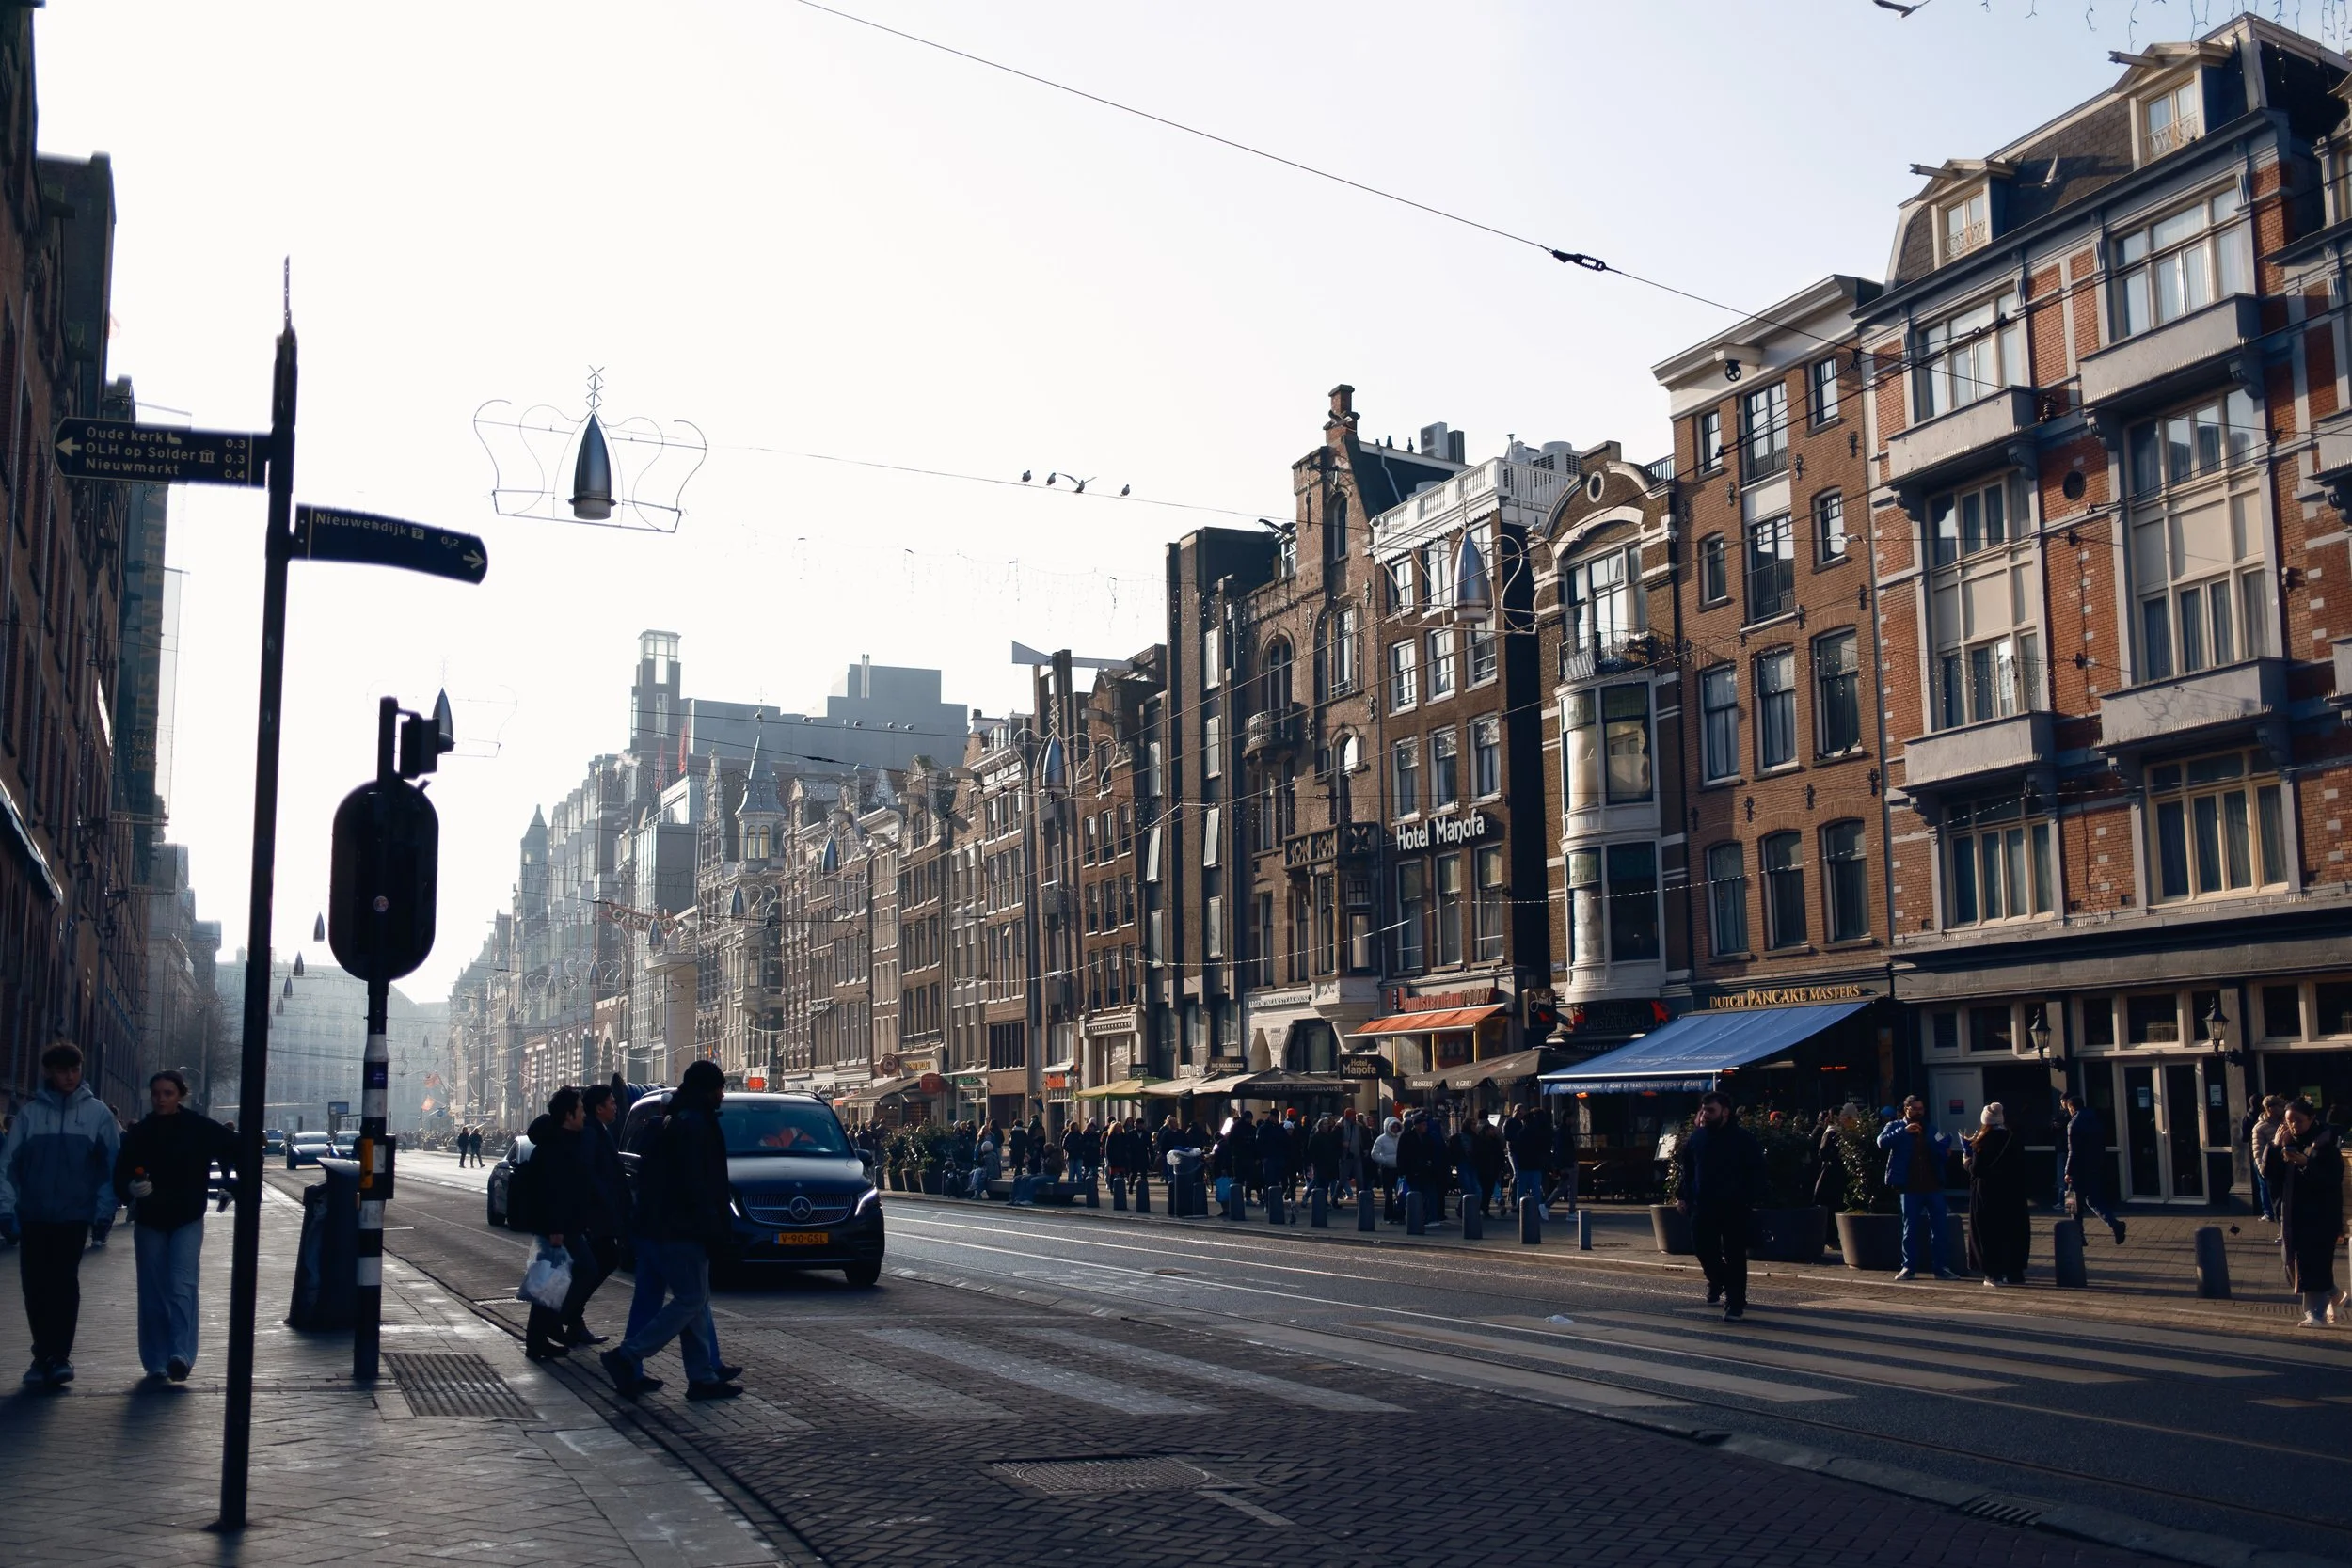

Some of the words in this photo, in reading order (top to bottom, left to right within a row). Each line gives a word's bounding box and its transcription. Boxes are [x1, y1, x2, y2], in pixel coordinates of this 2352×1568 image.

[87, 426, 125, 440] Oude
[131, 430, 164, 444] kerk
[225, 438, 246, 449] 0.3
[86, 442, 119, 455] OLH
[124, 448, 142, 458] op
[148, 447, 196, 461] Solder
[225, 453, 246, 464] 0.3
[86, 458, 179, 475] Nieuwmarkt
[224, 469, 245, 479] 0.4
[315, 512, 407, 536] Nieuwendijk
[1396, 819, 1429, 851] Hotel
[1434, 808, 1485, 845] Manofa
[1709, 994, 1744, 1009] DUTCH
[1747, 988, 1807, 1006] PANCAKE
[1809, 985, 1860, 1001] MASTERS
[1350, 1058, 1368, 1067] Hotel
[1292, 1084, 1344, 1092] STEAKHOUSE
